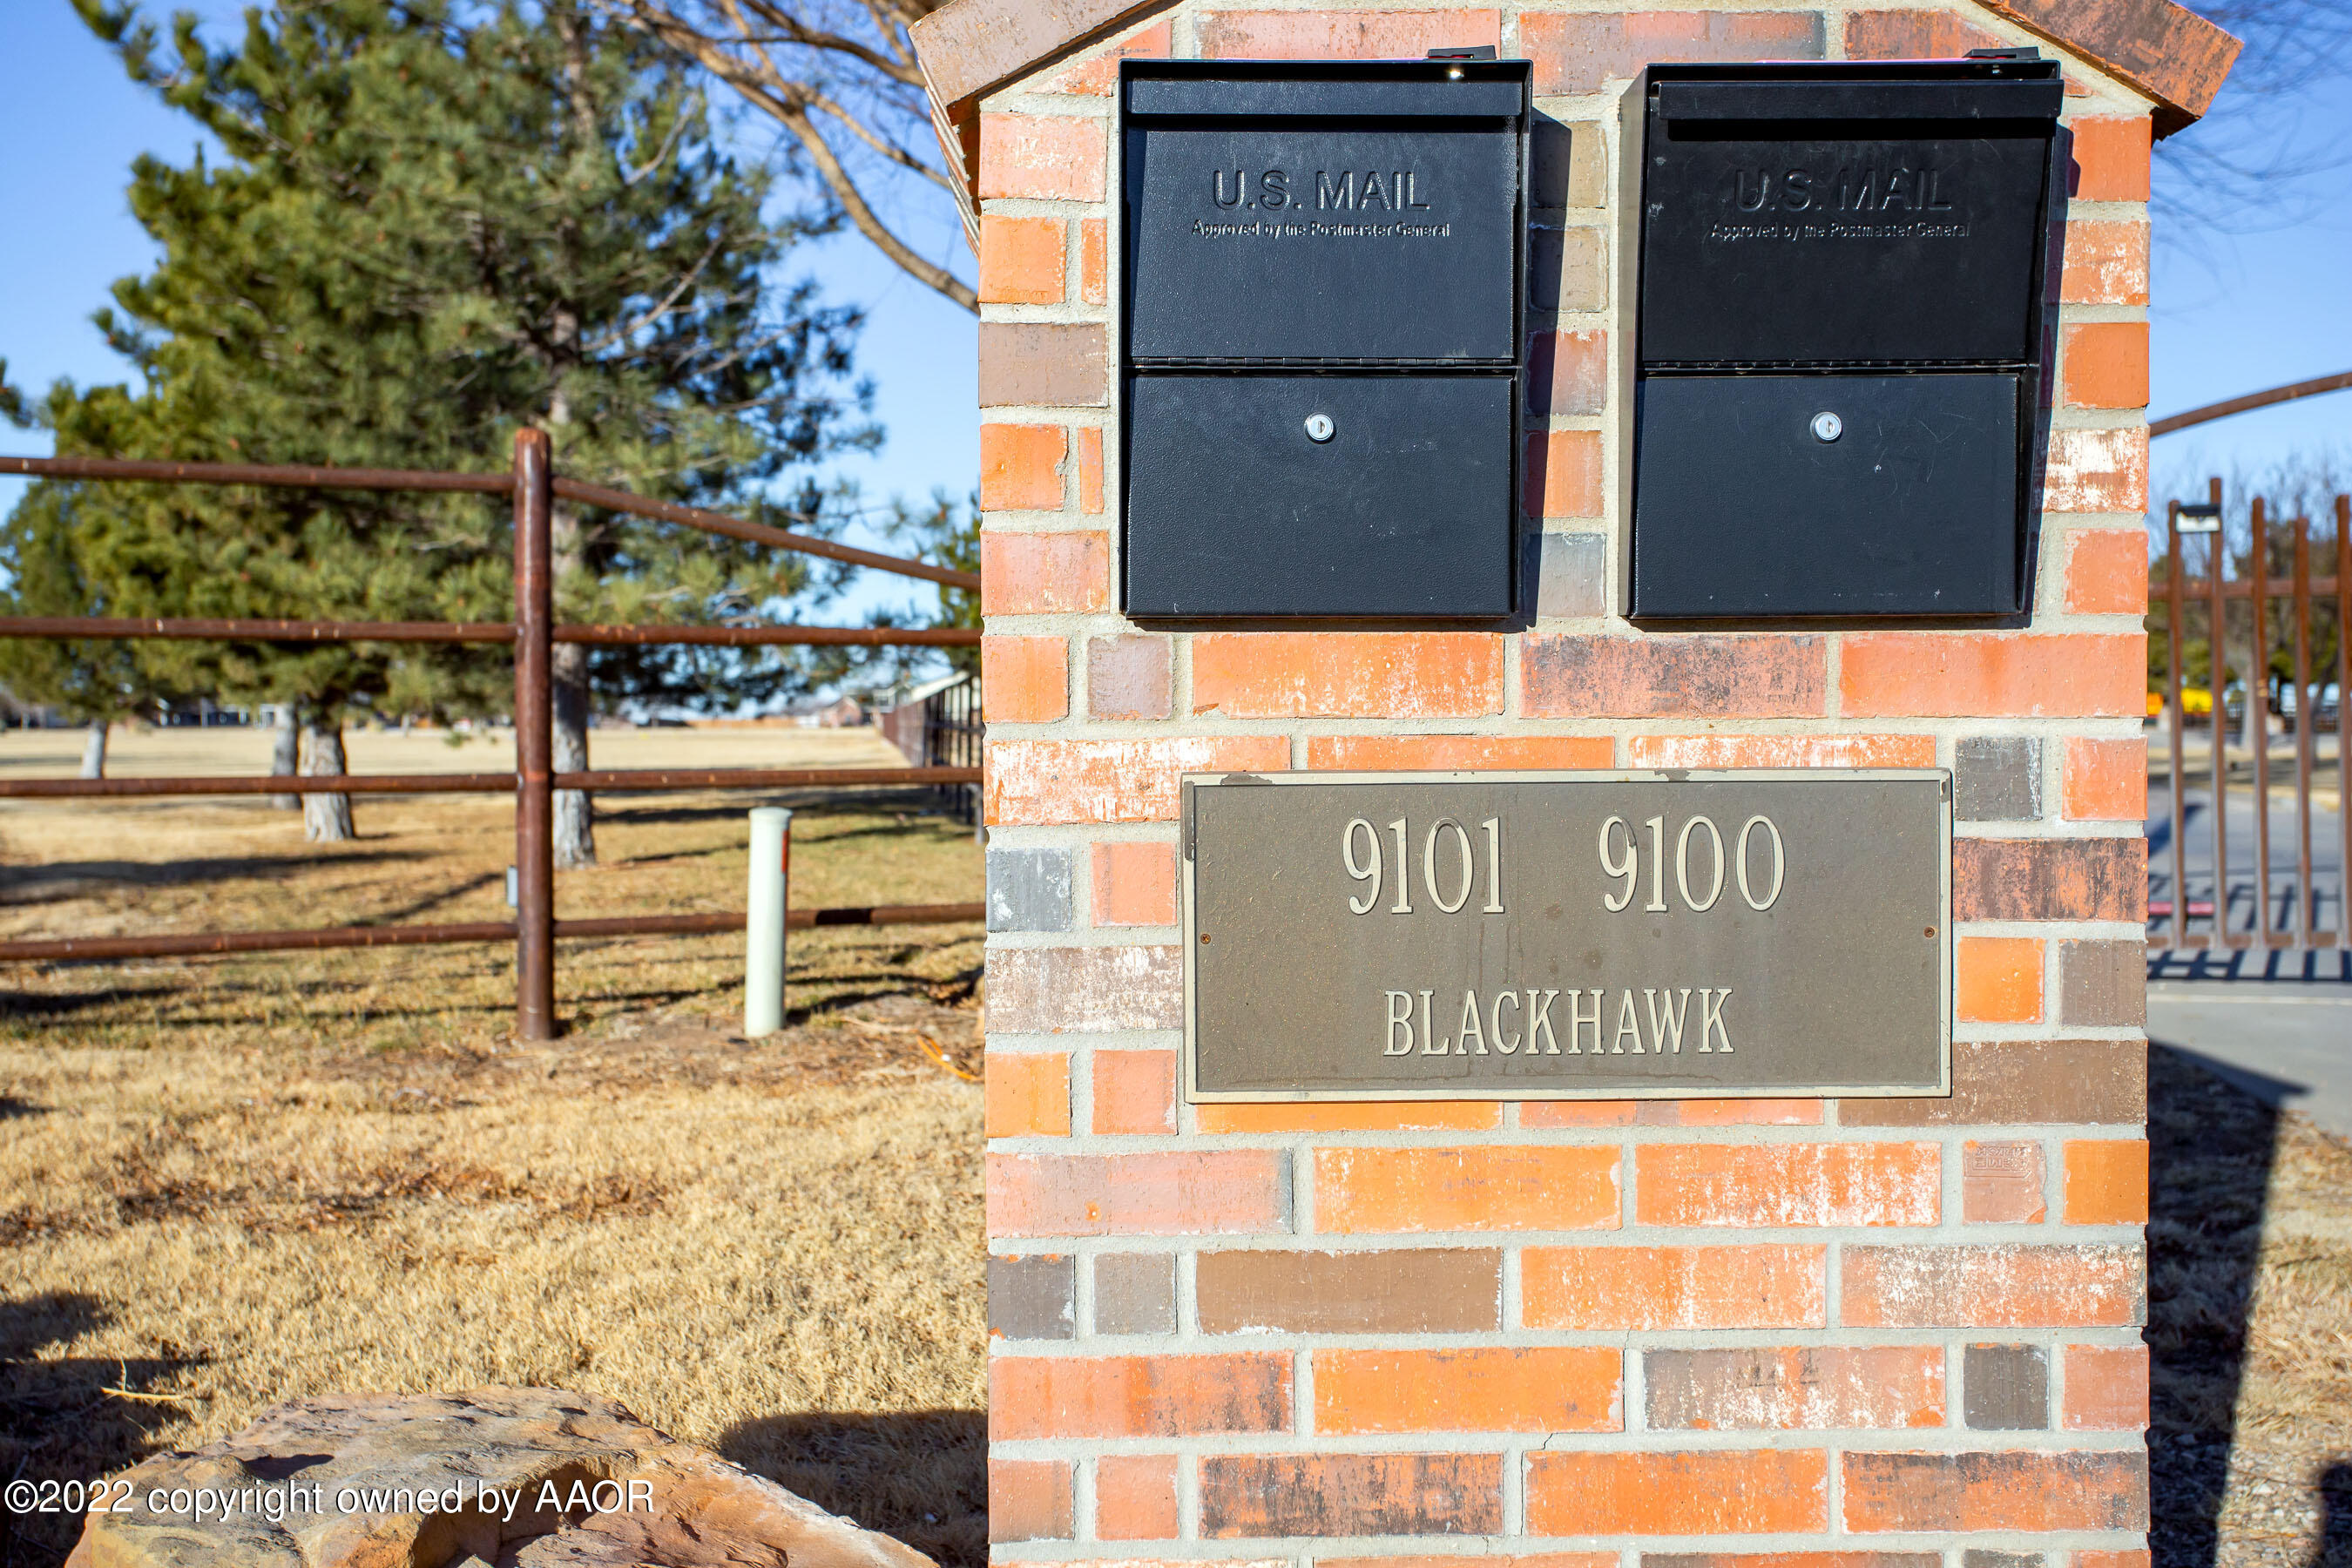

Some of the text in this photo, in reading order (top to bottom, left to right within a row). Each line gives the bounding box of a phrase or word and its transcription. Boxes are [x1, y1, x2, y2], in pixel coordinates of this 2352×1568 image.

[1213, 170, 1431, 210] U.S. MAIL
[1735, 168, 1952, 212] U.S. MAIL
[1192, 220, 1450, 240] Approved by the Postmaster General
[1711, 221, 1971, 242] Approved by the Postmaster General
[1342, 814, 1786, 915] 9101 9100
[1383, 987, 1734, 1057] BLACKHAWK
